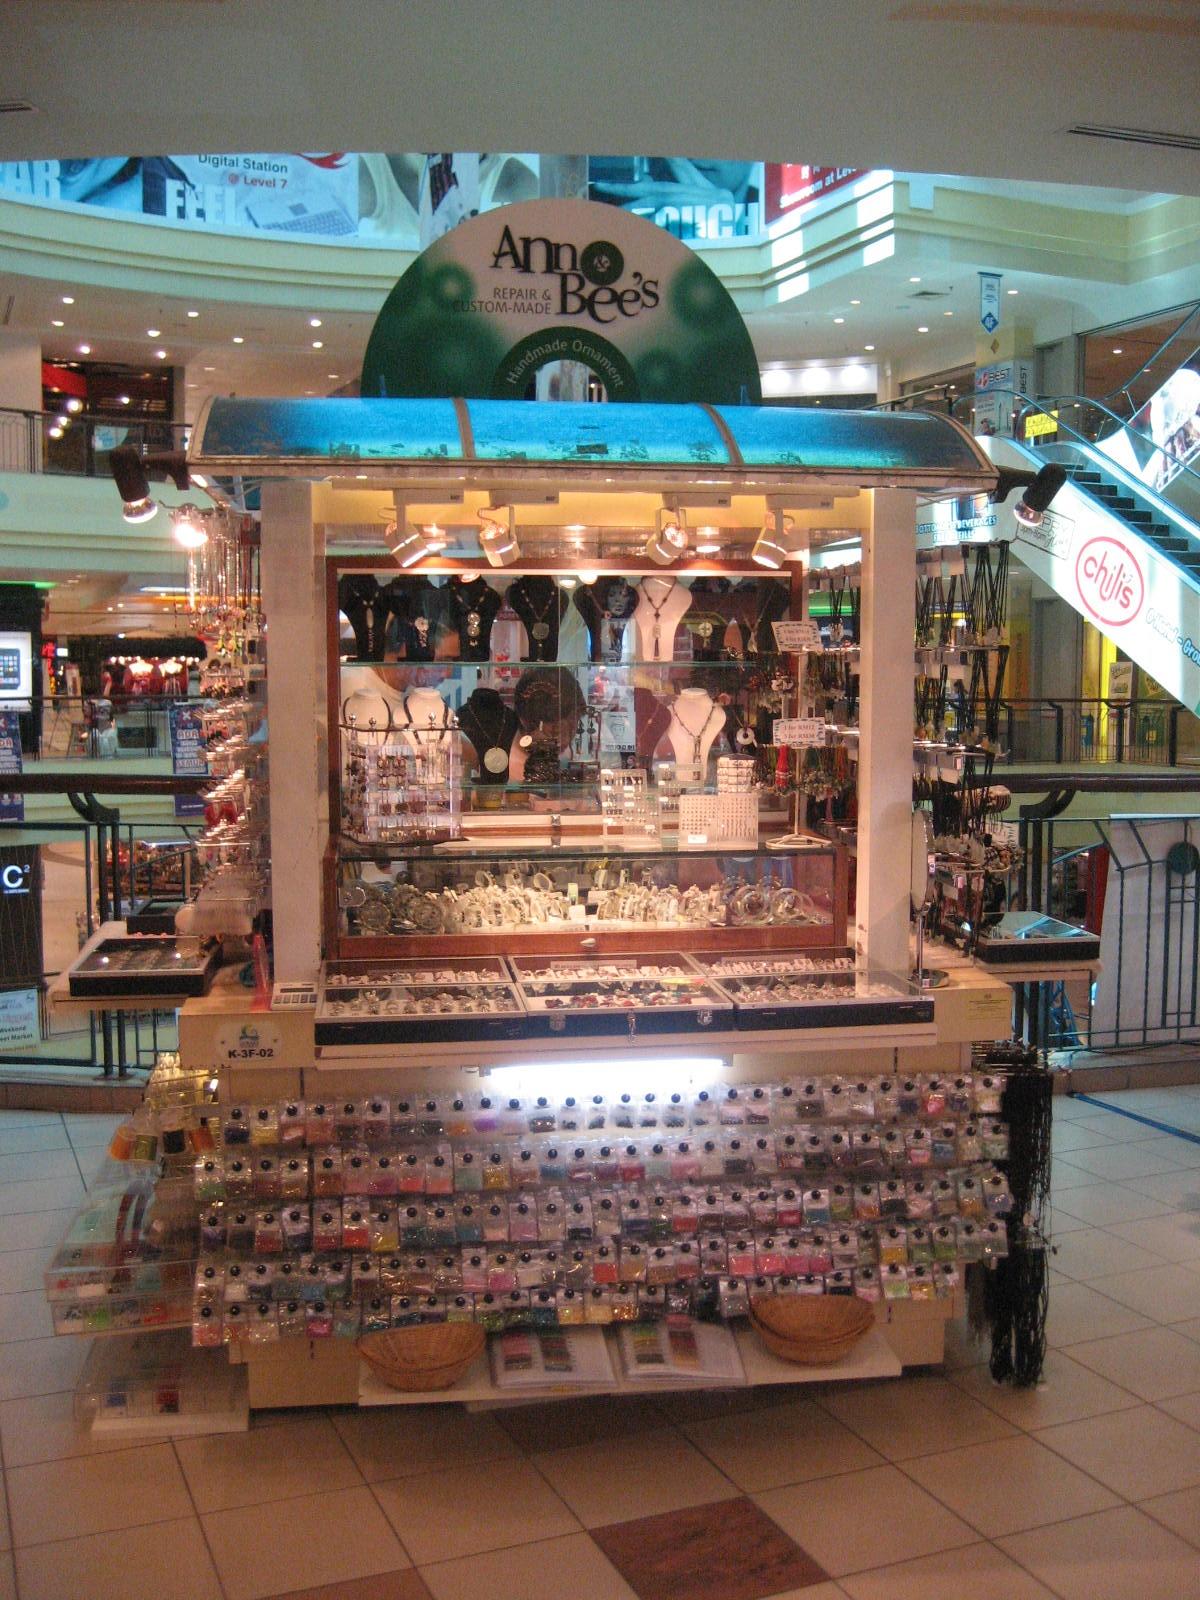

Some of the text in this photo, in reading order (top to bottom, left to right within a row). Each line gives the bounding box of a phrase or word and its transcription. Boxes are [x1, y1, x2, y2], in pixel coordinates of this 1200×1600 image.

[198, 153, 288, 173] Digital Station
[243, 175, 276, 188] Level
[280, 179, 288, 189] 7
[490, 224, 580, 274] Ann
[555, 271, 660, 323] Bee's
[493, 287, 552, 301] REPAIR &
[453, 300, 552, 314] CUSTOM-MADE
[506, 339, 624, 386] Handmade Ornament
[989, 367, 1011, 383] BEST
[228, 1048, 274, 1059] K-3F-02
